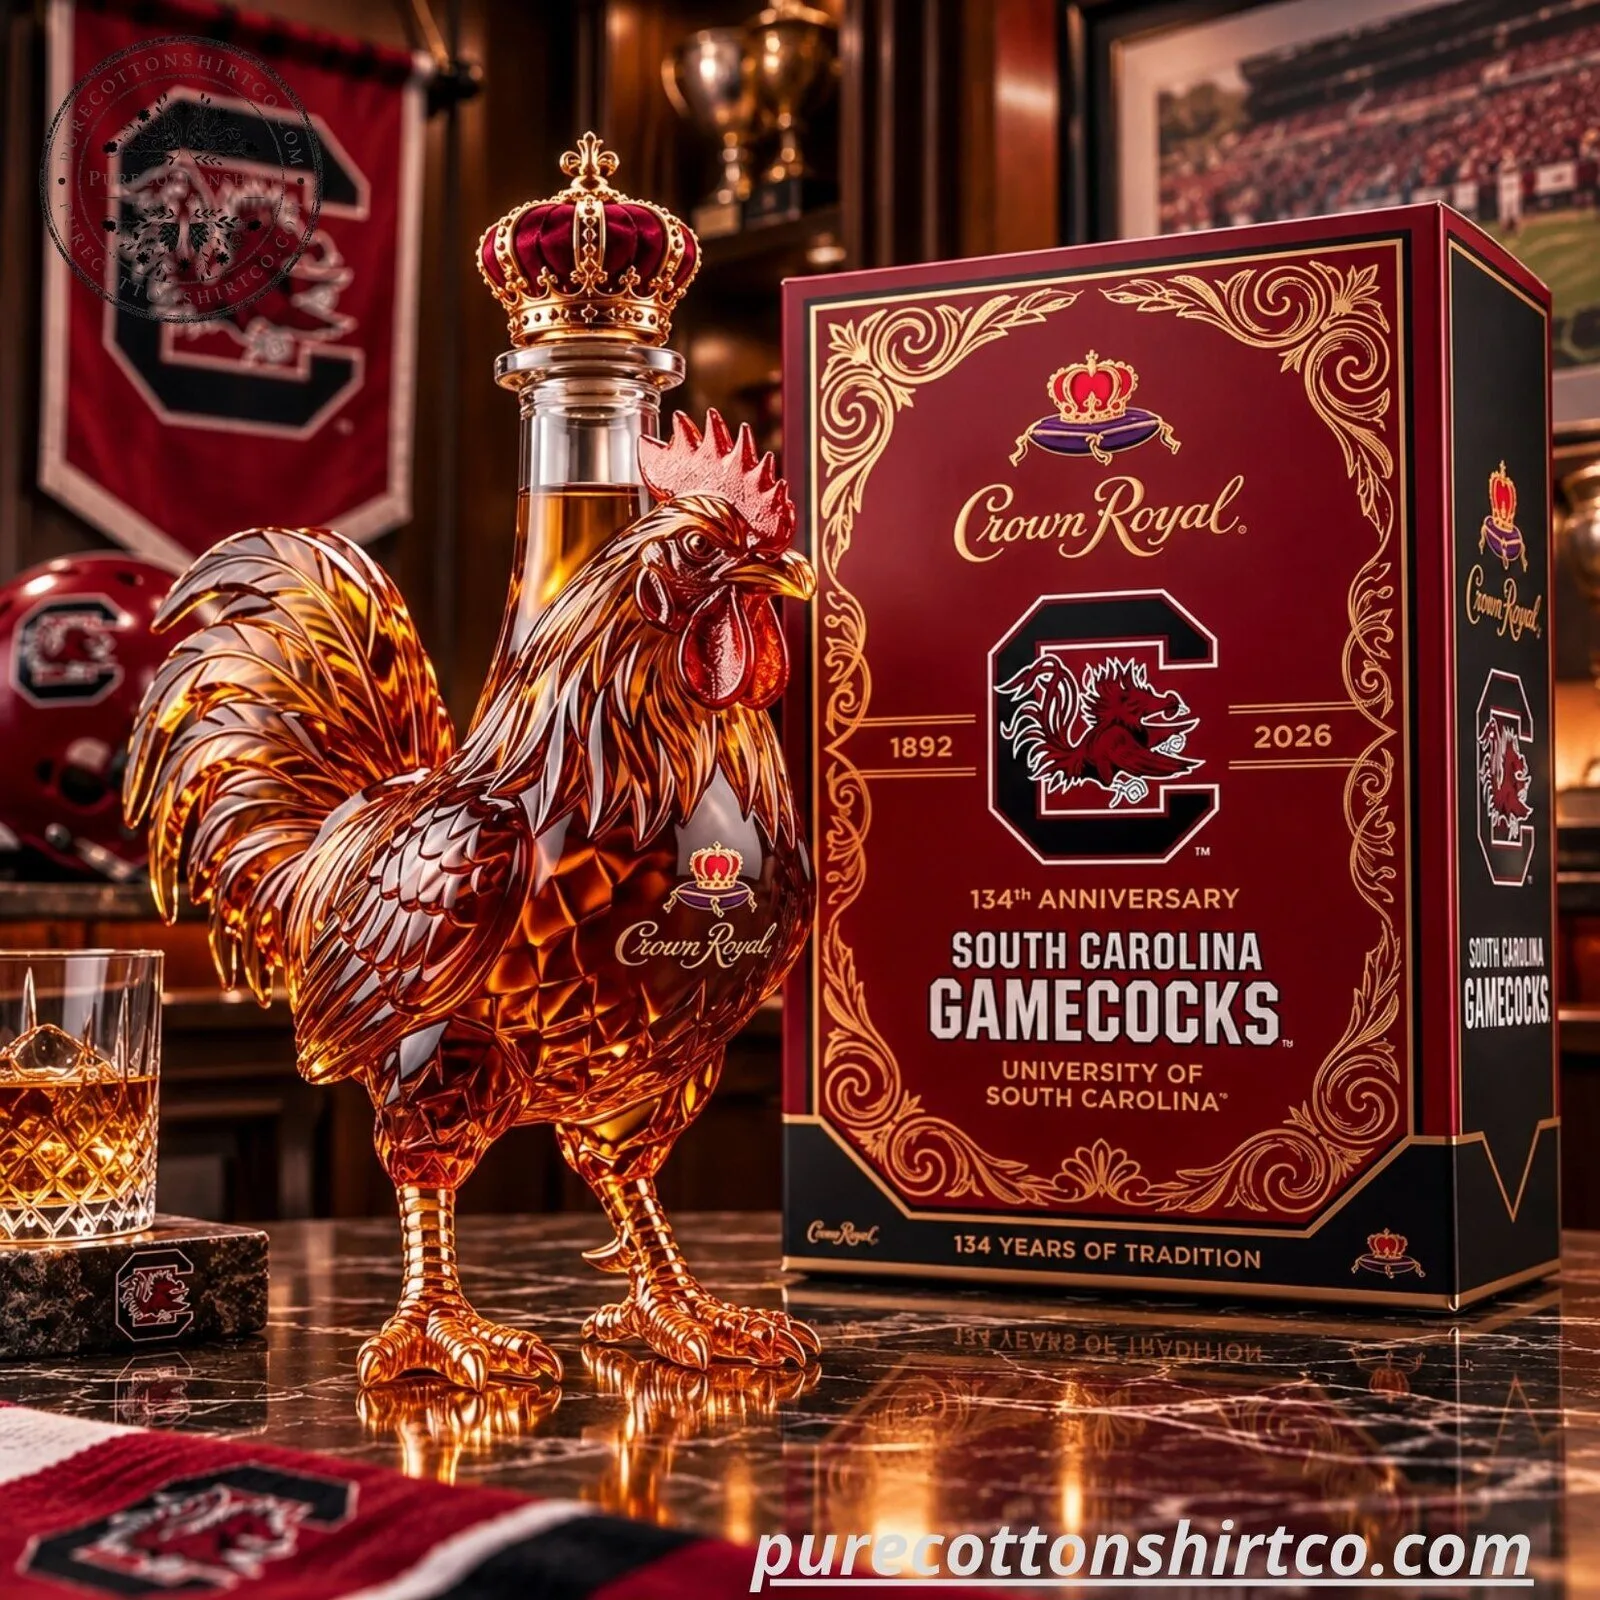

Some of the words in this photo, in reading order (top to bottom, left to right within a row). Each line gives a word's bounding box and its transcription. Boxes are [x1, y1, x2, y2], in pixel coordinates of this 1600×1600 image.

[953, 483, 1088, 563] Crown
[1058, 474, 1245, 559] Royal
[1466, 564, 1503, 625] Crown
[889, 736, 953, 759] 1892
[1253, 723, 1333, 750] 2026
[970, 887, 1031, 910] 134th
[1038, 888, 1240, 910] ANNIVERSARY
[614, 920, 701, 967] Crown
[680, 922, 778, 969] Royal
[952, 931, 1067, 970] SOUTH
[1080, 931, 1263, 971] CAROLINA
[1468, 936, 1500, 969] SOUTH
[1501, 936, 1544, 968] CAROLINA
[929, 977, 1280, 1046] GAMECOCKS
[1464, 974, 1549, 1030] GAMECOCKS
[1002, 1060, 1158, 1083] UNIVERSITY
[1167, 1063, 1203, 1084] OF
[986, 1085, 1073, 1108] SOUTH
[1081, 1088, 1220, 1112] CAROLINA
[953, 1234, 992, 1256] 134
[999, 1237, 1076, 1260] YEARS
[1084, 1242, 1116, 1262] OF
[1124, 1243, 1262, 1270] TRADITION
